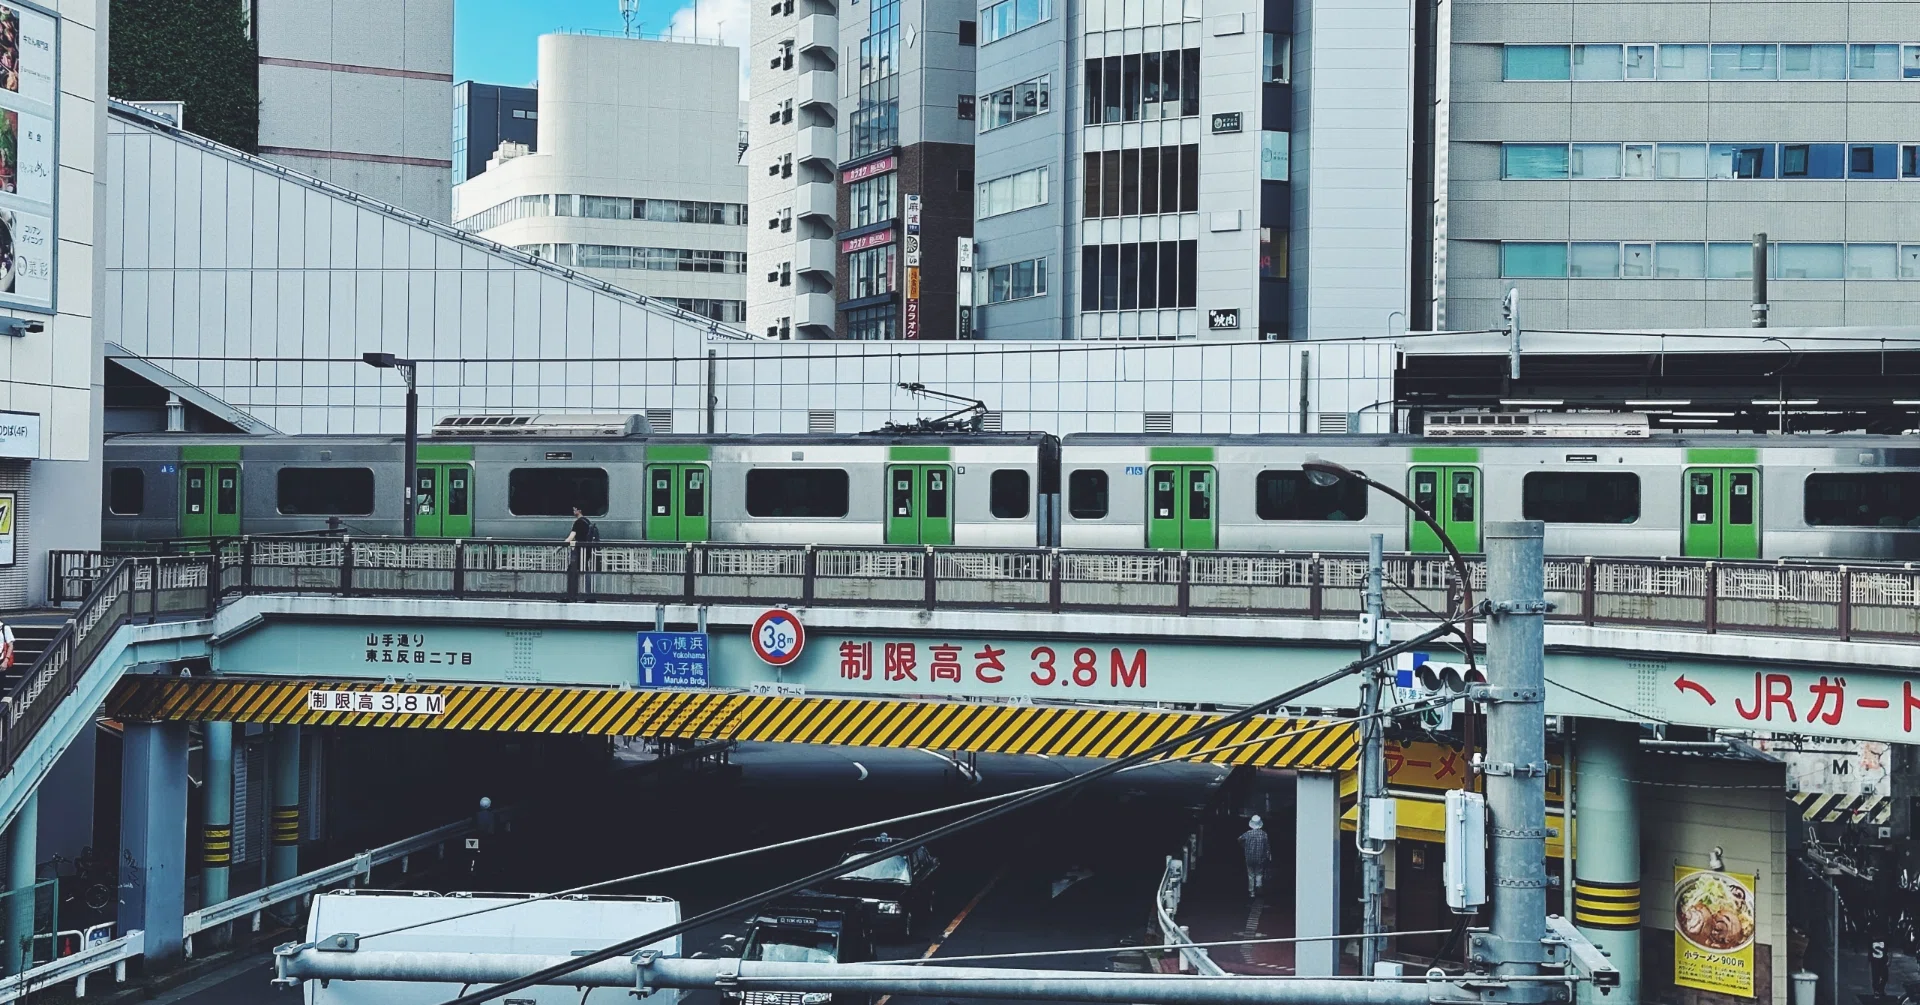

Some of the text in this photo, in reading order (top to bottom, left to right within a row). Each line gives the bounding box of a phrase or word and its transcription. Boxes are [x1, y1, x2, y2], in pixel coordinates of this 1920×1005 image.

[907, 303, 917, 338] カラオケ
[366, 633, 424, 647] 山手通り
[662, 637, 703, 650] 1 横浜
[365, 649, 472, 665] 東五反田二丁目
[642, 656, 654, 665] 317
[672, 651, 706, 660] Yokohama
[839, 640, 1005, 684] 制限高さ
[663, 662, 704, 676] 丸子橋
[664, 676, 707, 686] Maruko Brdg.
[1833, 760, 1848, 774] M
[1872, 942, 1885, 958] S
[1685, 950, 1744, 968] 小ラーメン 900円
